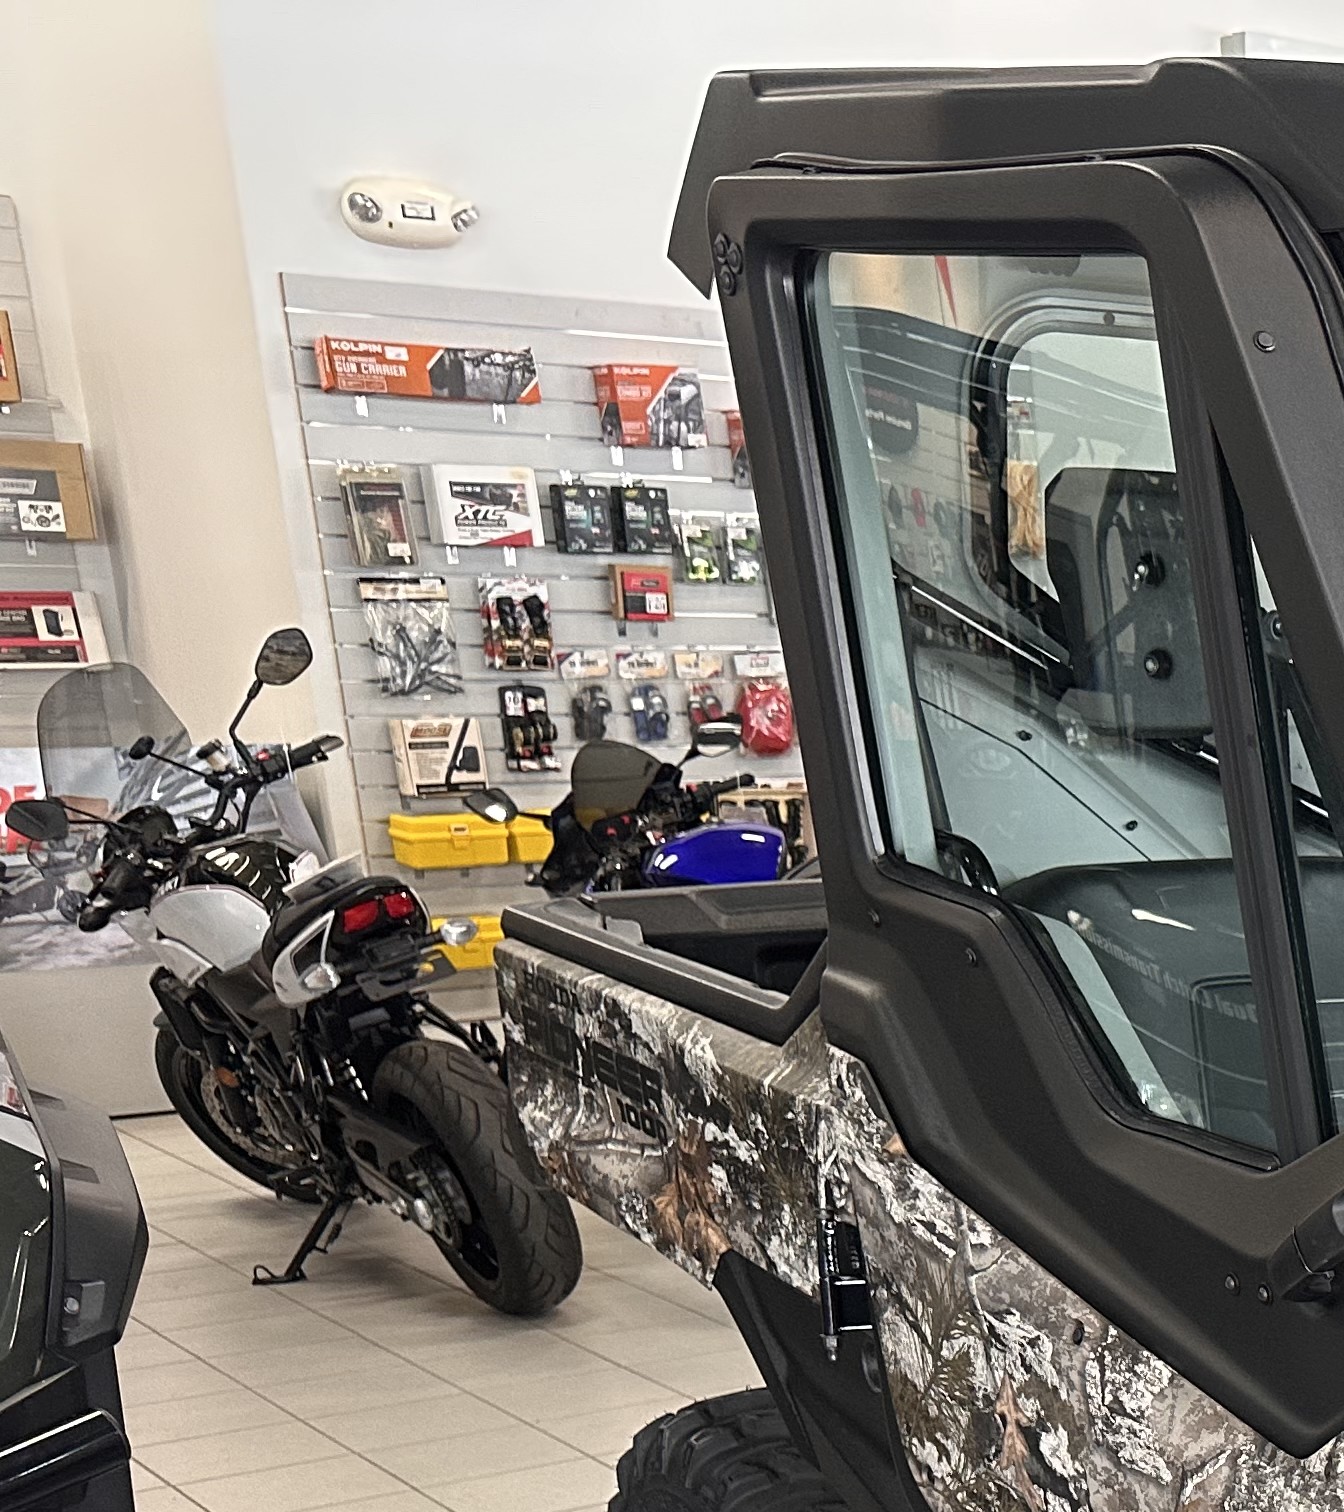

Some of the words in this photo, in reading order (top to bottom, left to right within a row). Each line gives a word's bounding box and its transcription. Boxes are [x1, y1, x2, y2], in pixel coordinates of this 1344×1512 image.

[330, 340, 383, 354] KOLPIN
[335, 362, 357, 374] GUN
[361, 363, 407, 377] CARRIER
[458, 504, 507, 520] XTC
[617, 1098, 669, 1146] 1000
